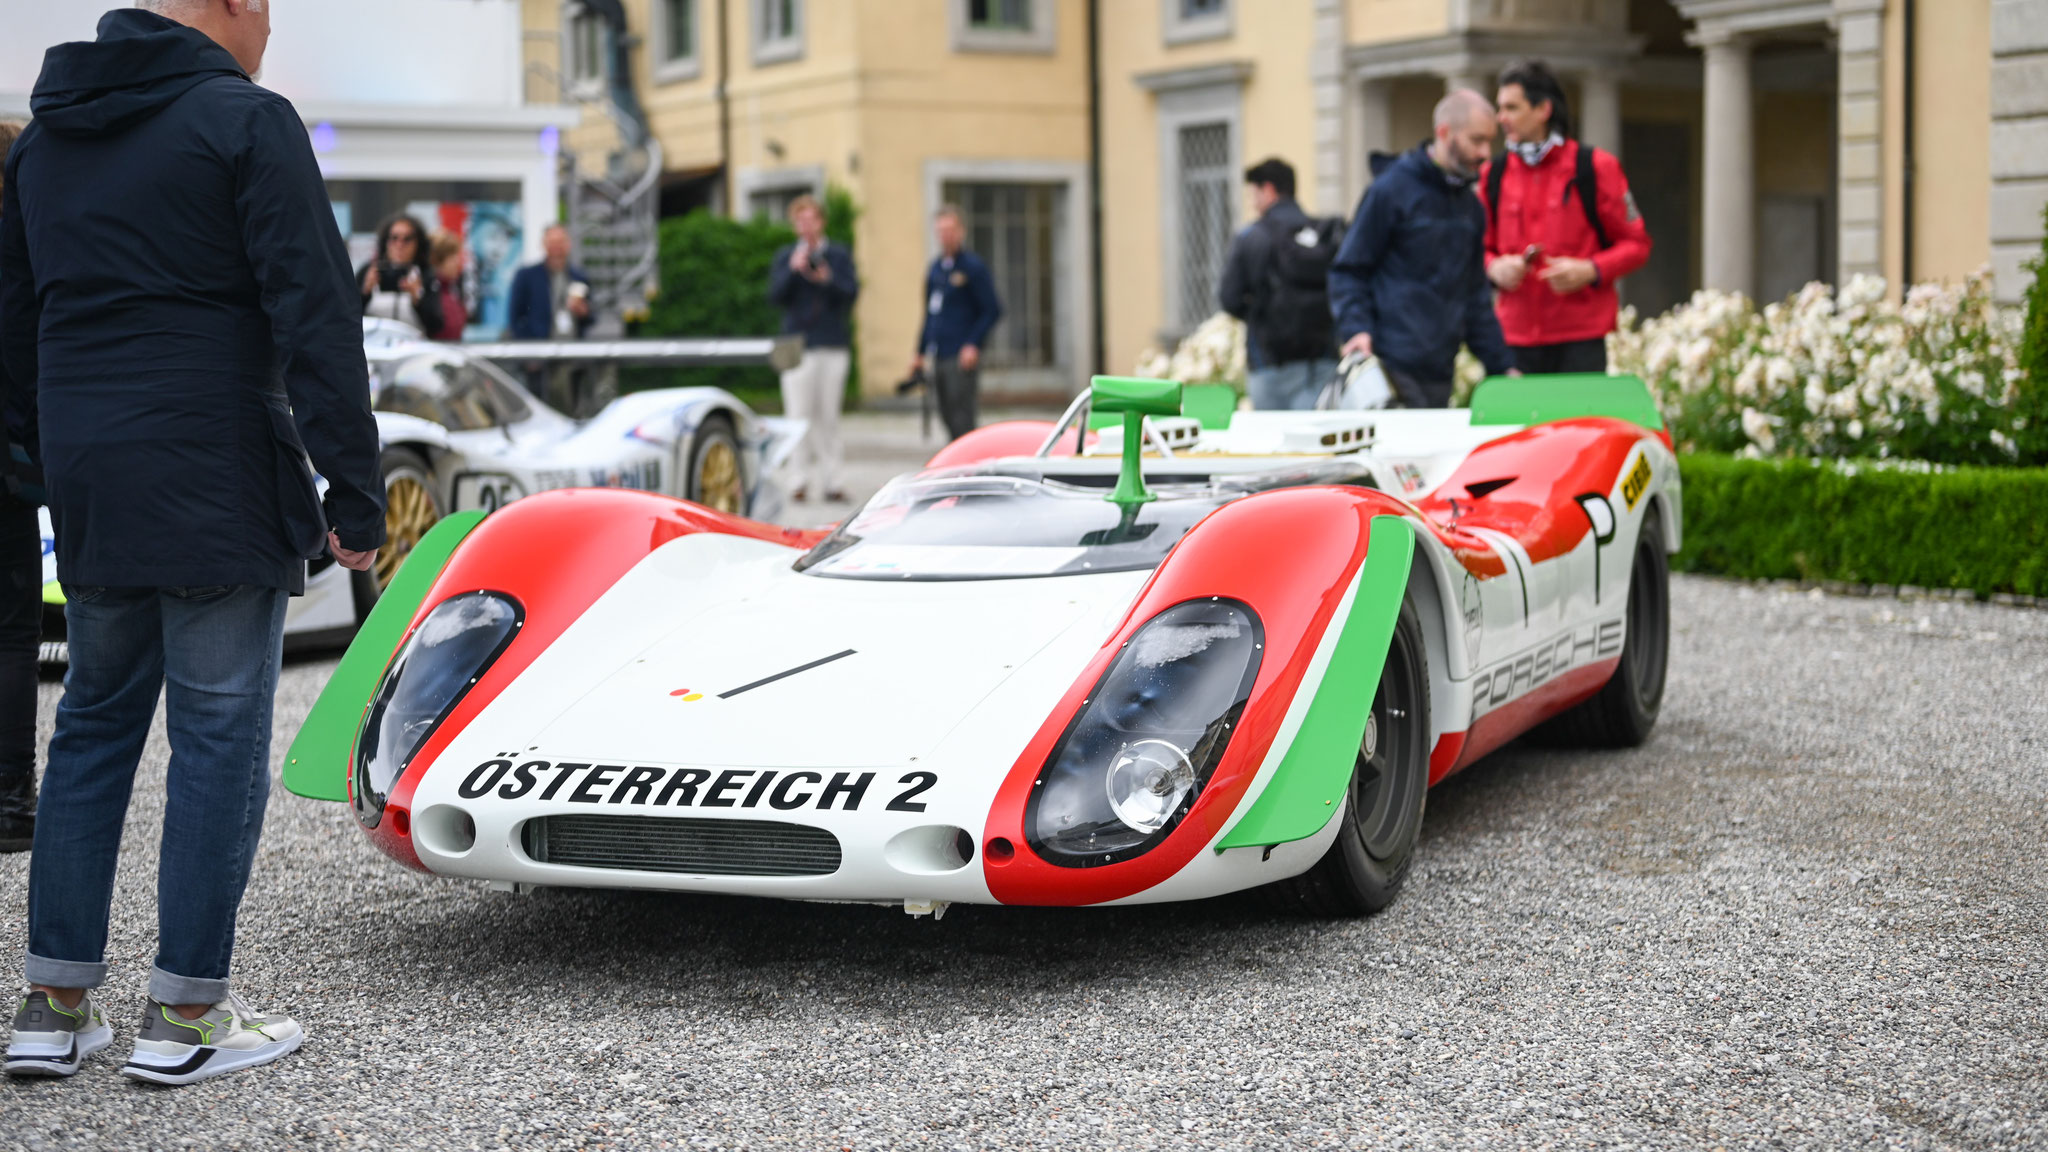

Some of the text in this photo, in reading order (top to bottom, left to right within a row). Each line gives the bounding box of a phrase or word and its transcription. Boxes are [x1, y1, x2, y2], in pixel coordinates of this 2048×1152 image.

[1470, 618, 1622, 724] PORSCHE
[458, 752, 938, 813] ÖSTERREICH 2
